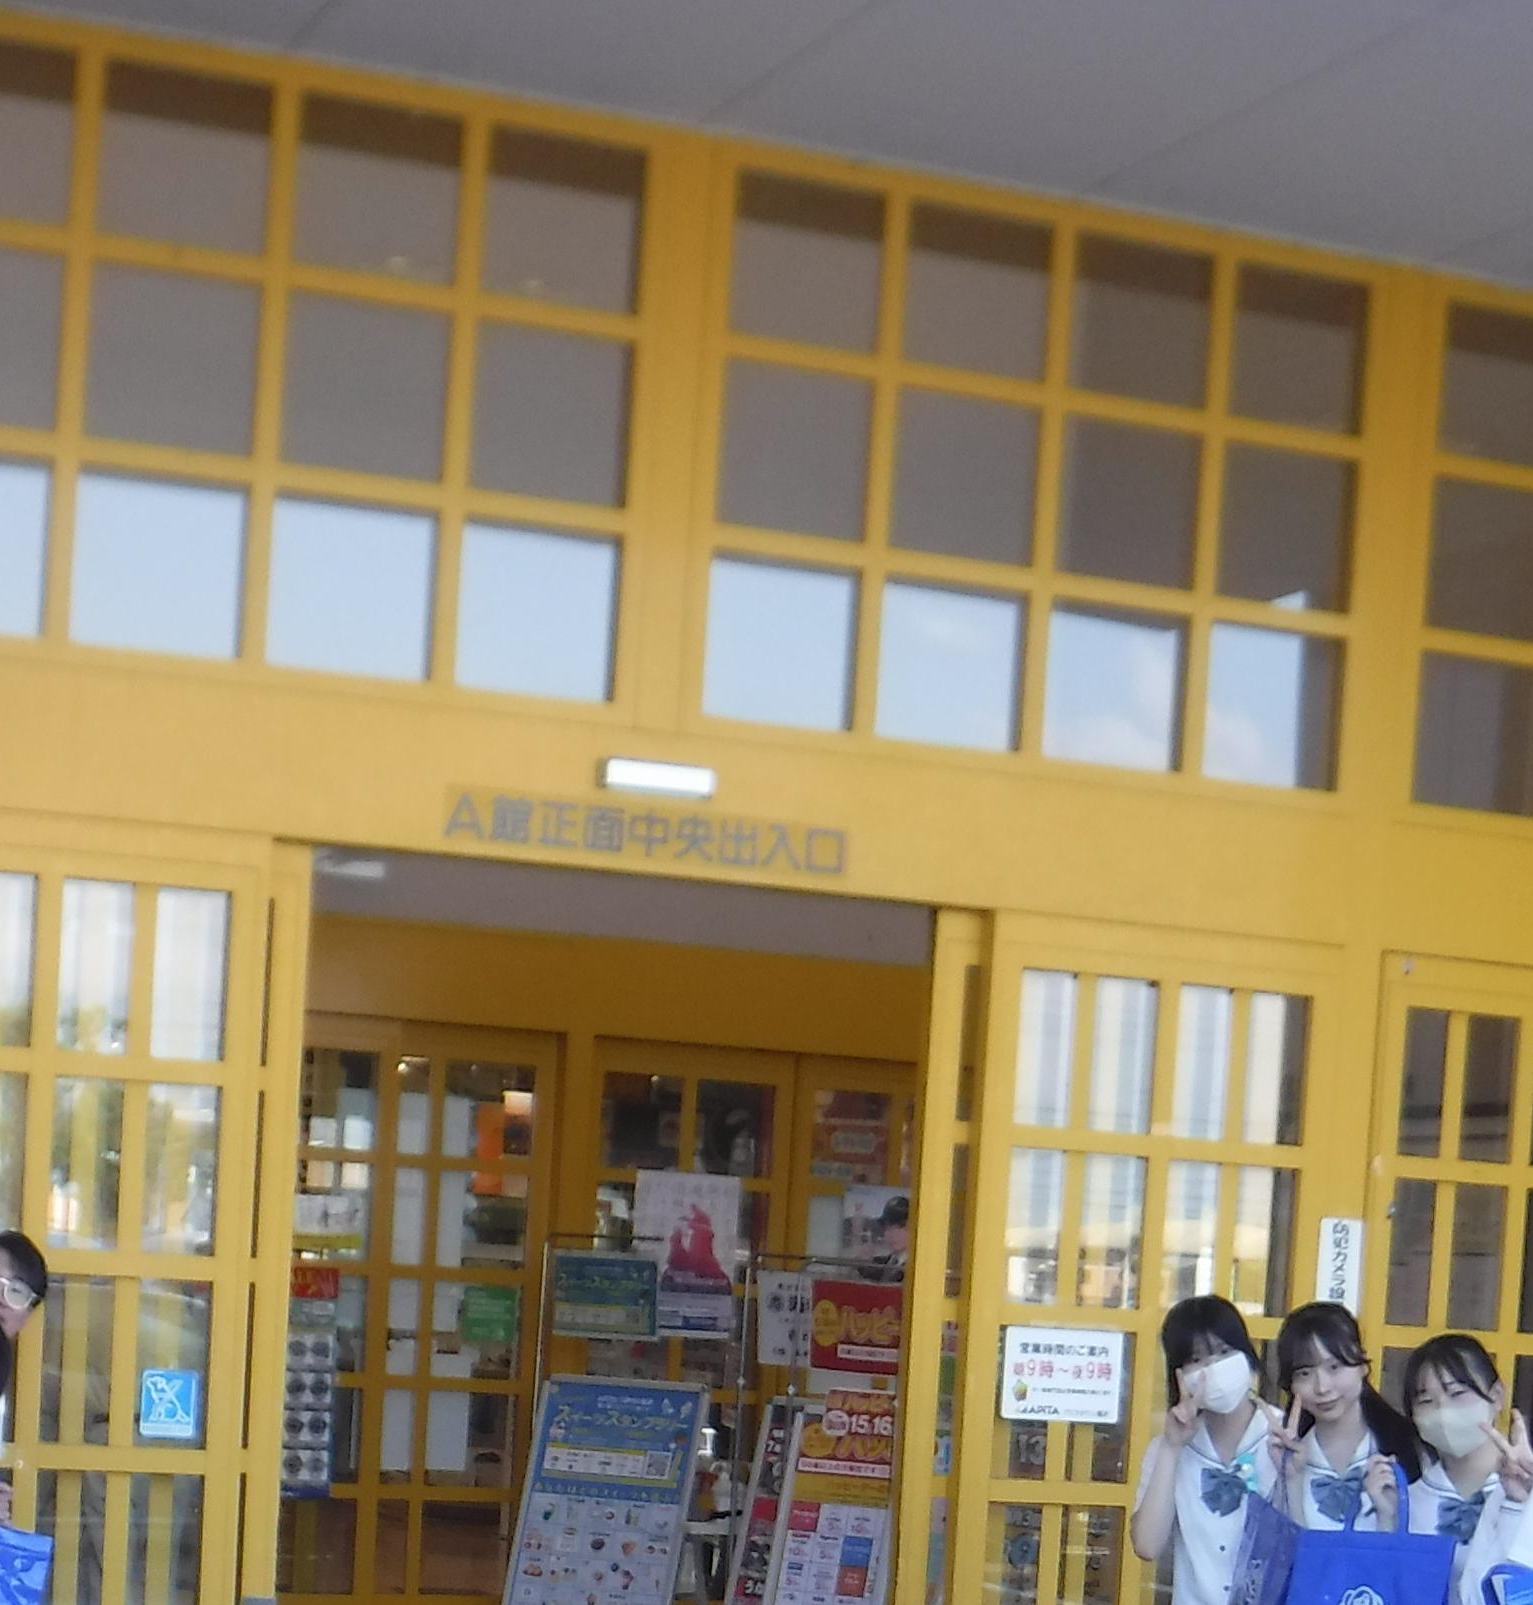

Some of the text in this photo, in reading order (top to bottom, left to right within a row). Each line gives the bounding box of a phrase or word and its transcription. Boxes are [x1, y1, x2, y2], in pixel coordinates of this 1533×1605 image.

[444, 792, 848, 875] A館正面中央出入口
